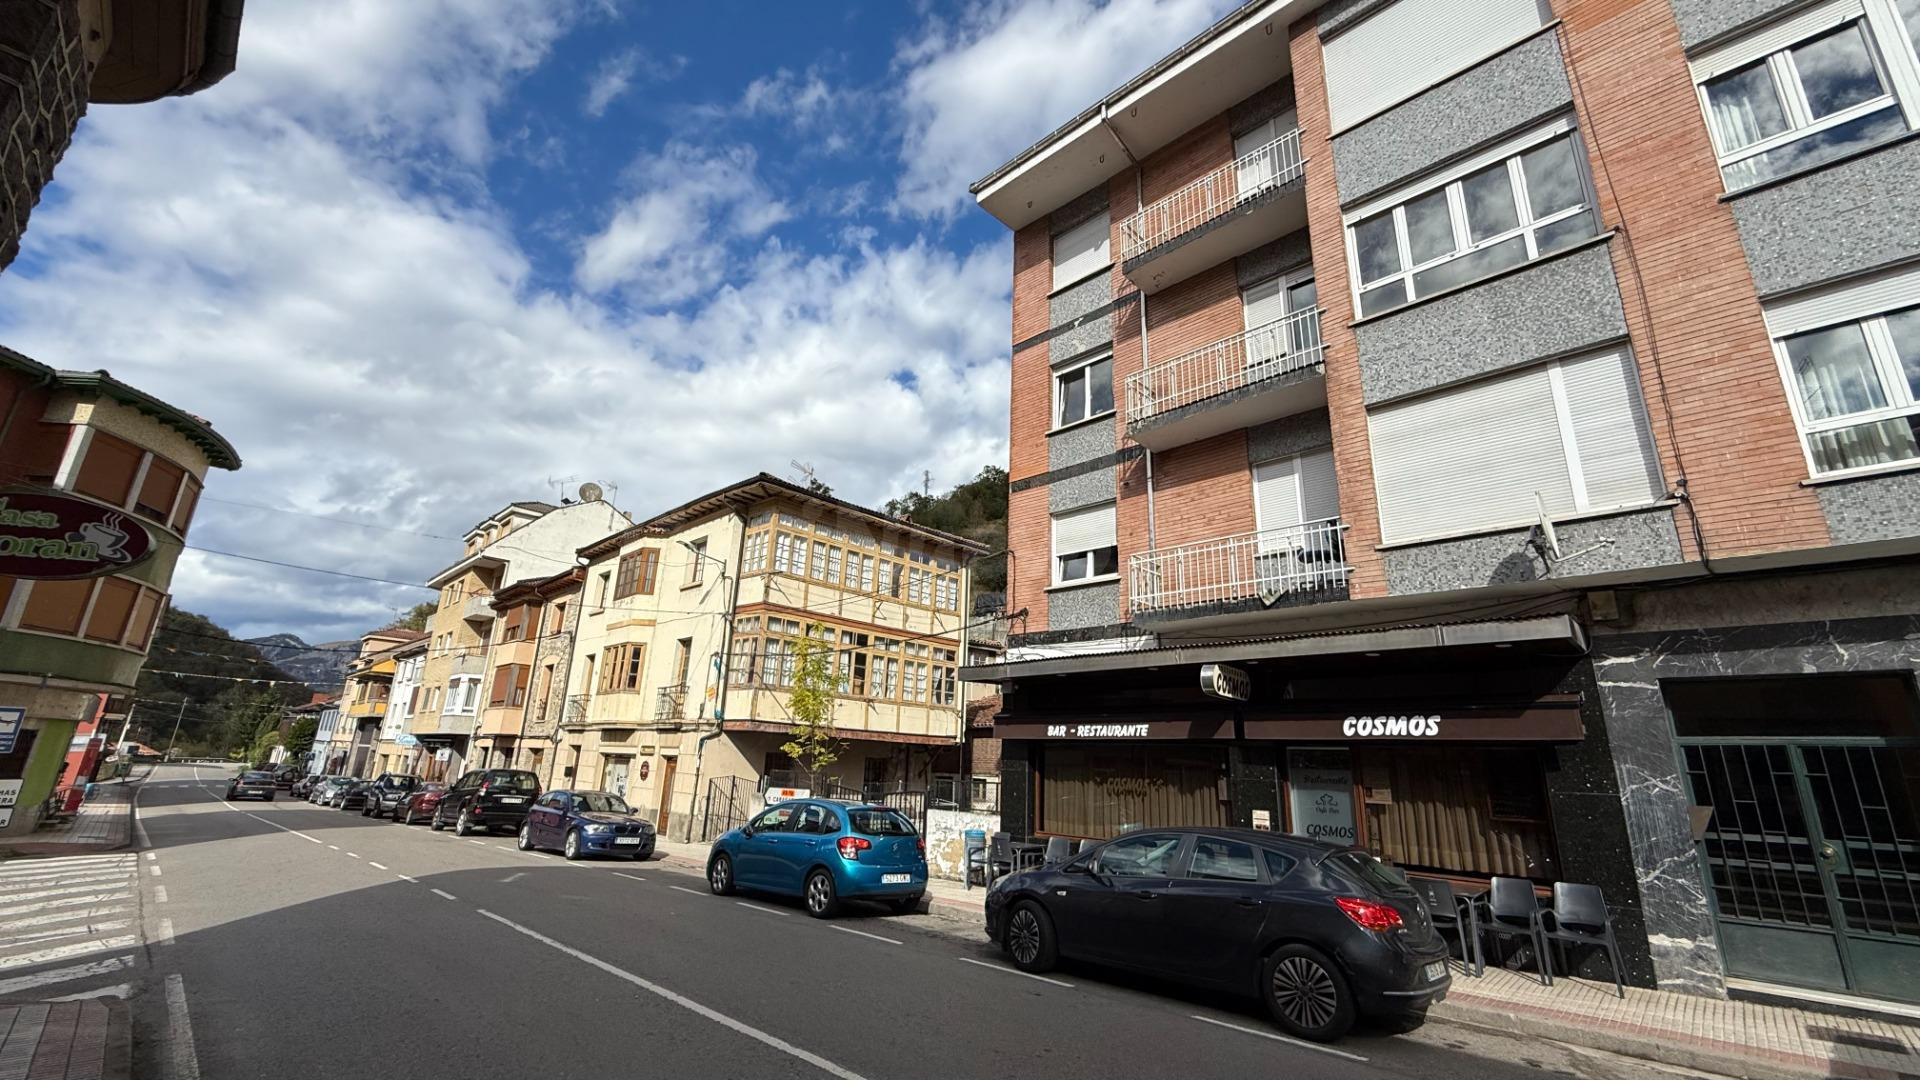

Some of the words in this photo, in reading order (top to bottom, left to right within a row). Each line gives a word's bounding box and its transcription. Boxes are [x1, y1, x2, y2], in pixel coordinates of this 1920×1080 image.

[0, 535, 99, 562] oran
[1047, 725, 1066, 737] BAR
[1077, 724, 1149, 737] RESTAURANTE
[1343, 715, 1441, 736] COSMOS
[1306, 824, 1354, 839] COSMOS
